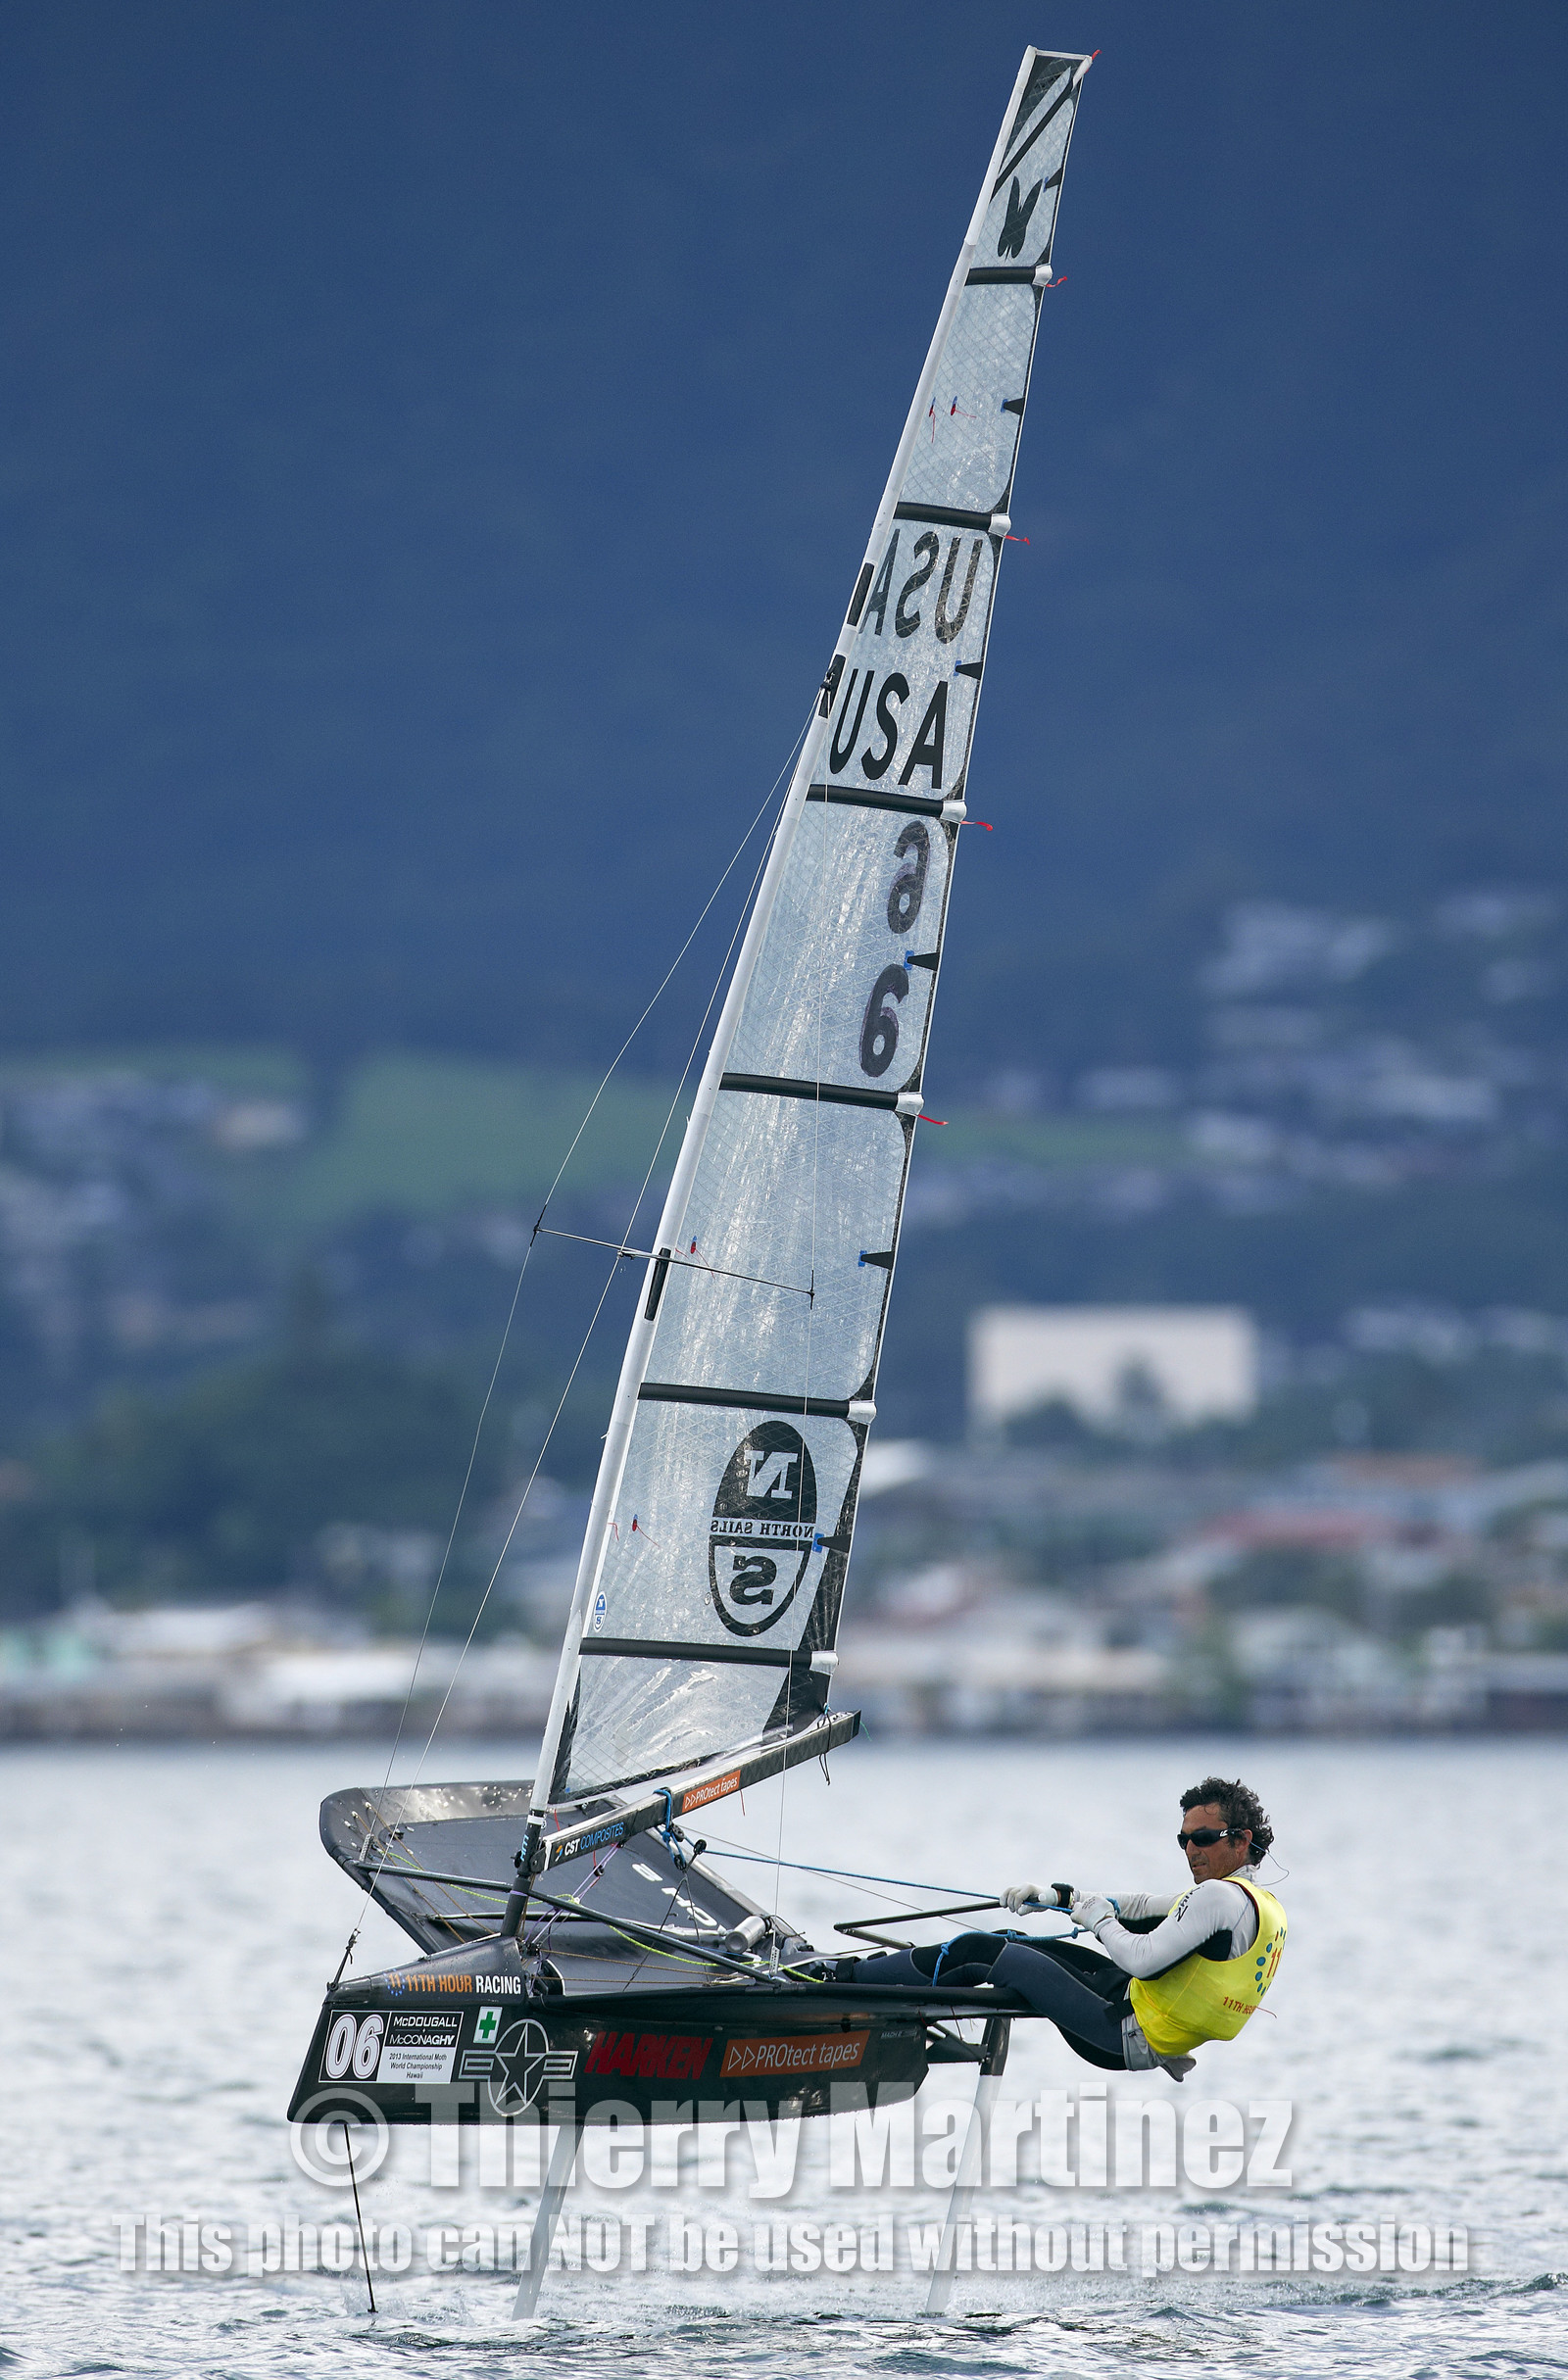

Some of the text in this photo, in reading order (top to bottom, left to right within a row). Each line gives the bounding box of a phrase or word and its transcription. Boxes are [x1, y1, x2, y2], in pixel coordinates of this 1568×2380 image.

[830, 668, 949, 789] USA
[859, 964, 909, 1077] 6
[720, 1777, 738, 1793] tapes
[564, 1822, 624, 1856] CST COMPOSITES
[405, 1974, 521, 1995] 11TH HOUR RACING
[1223, 1997, 1244, 2013] 11TH
[393, 2016, 458, 2027] McDOUGALL
[325, 2014, 384, 2080] 06
[389, 2034, 456, 2045] McCONAGHY
[407, 2062, 443, 2071] Championship
[584, 2031, 713, 2079] HARKEN
[756, 2042, 860, 2068] PROtect tapes
